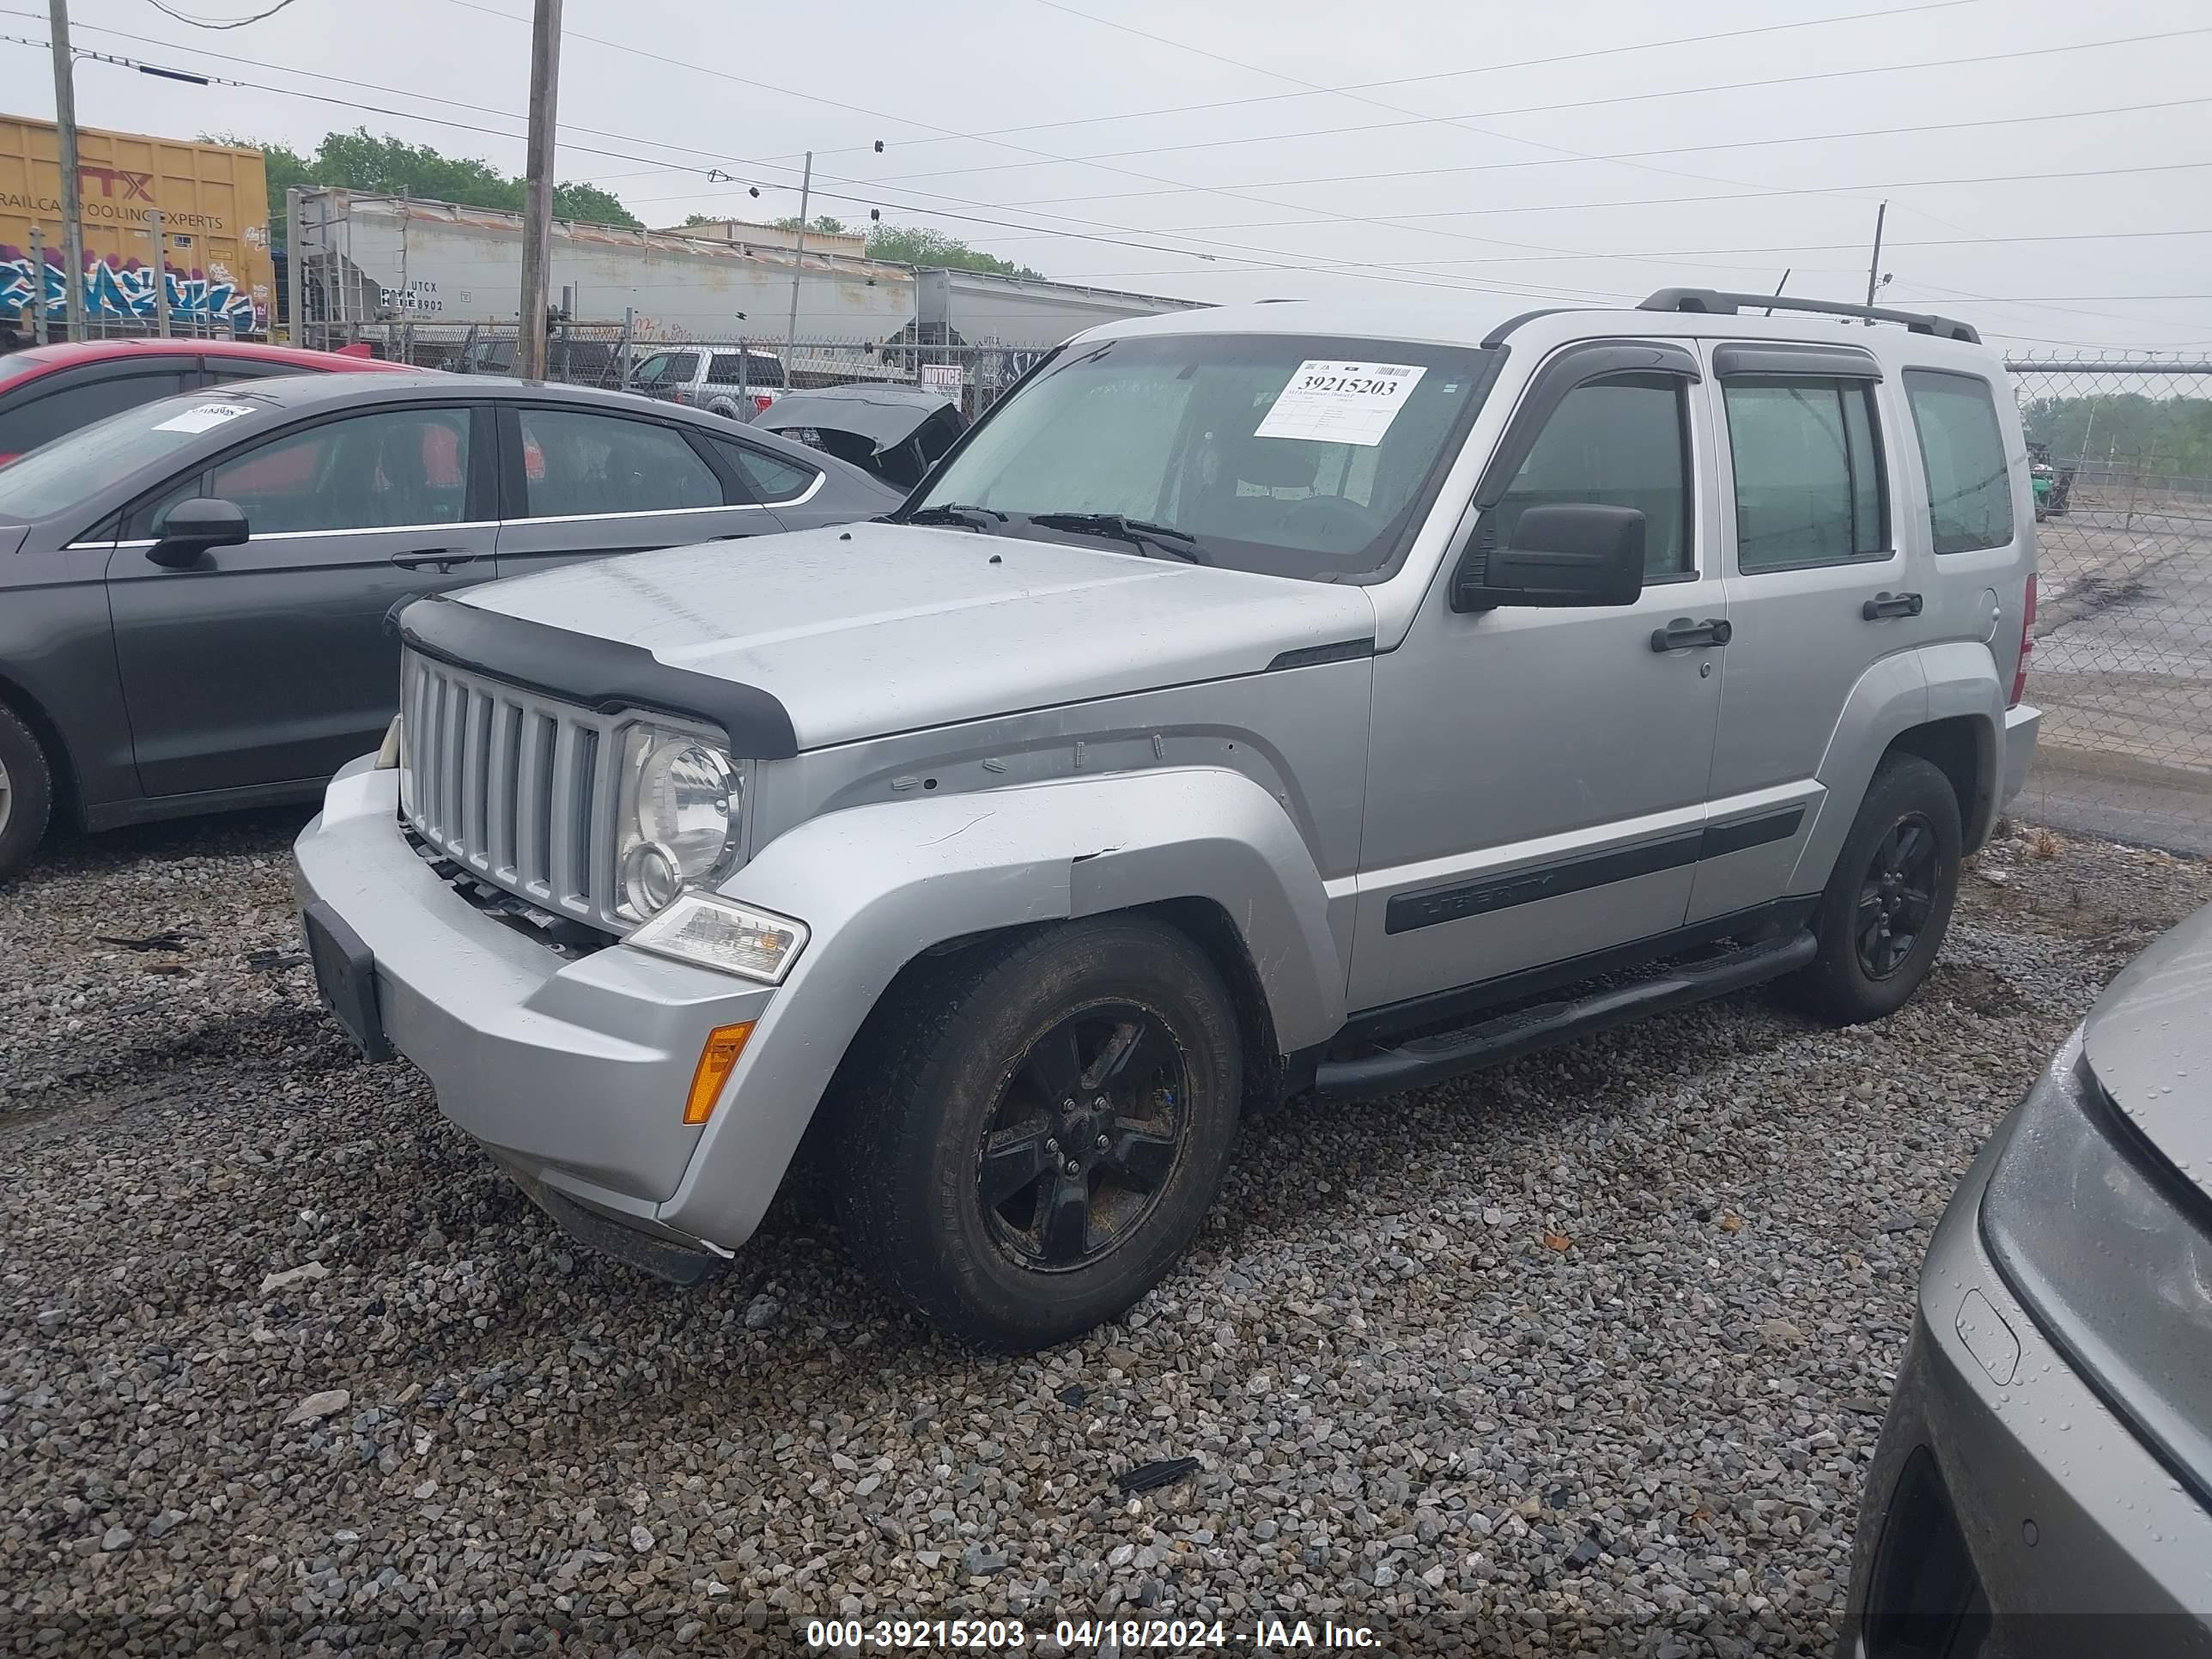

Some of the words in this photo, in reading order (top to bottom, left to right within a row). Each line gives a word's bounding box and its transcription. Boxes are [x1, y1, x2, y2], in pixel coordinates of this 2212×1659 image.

[0, 192, 63, 213] RAILCA
[412, 281, 437, 293] UTCX
[417, 300, 443, 311] 8902
[924, 368, 961, 386] NOTICE
[1297, 375, 1398, 397] 39215203
[1421, 874, 1556, 915] LIBERTY
